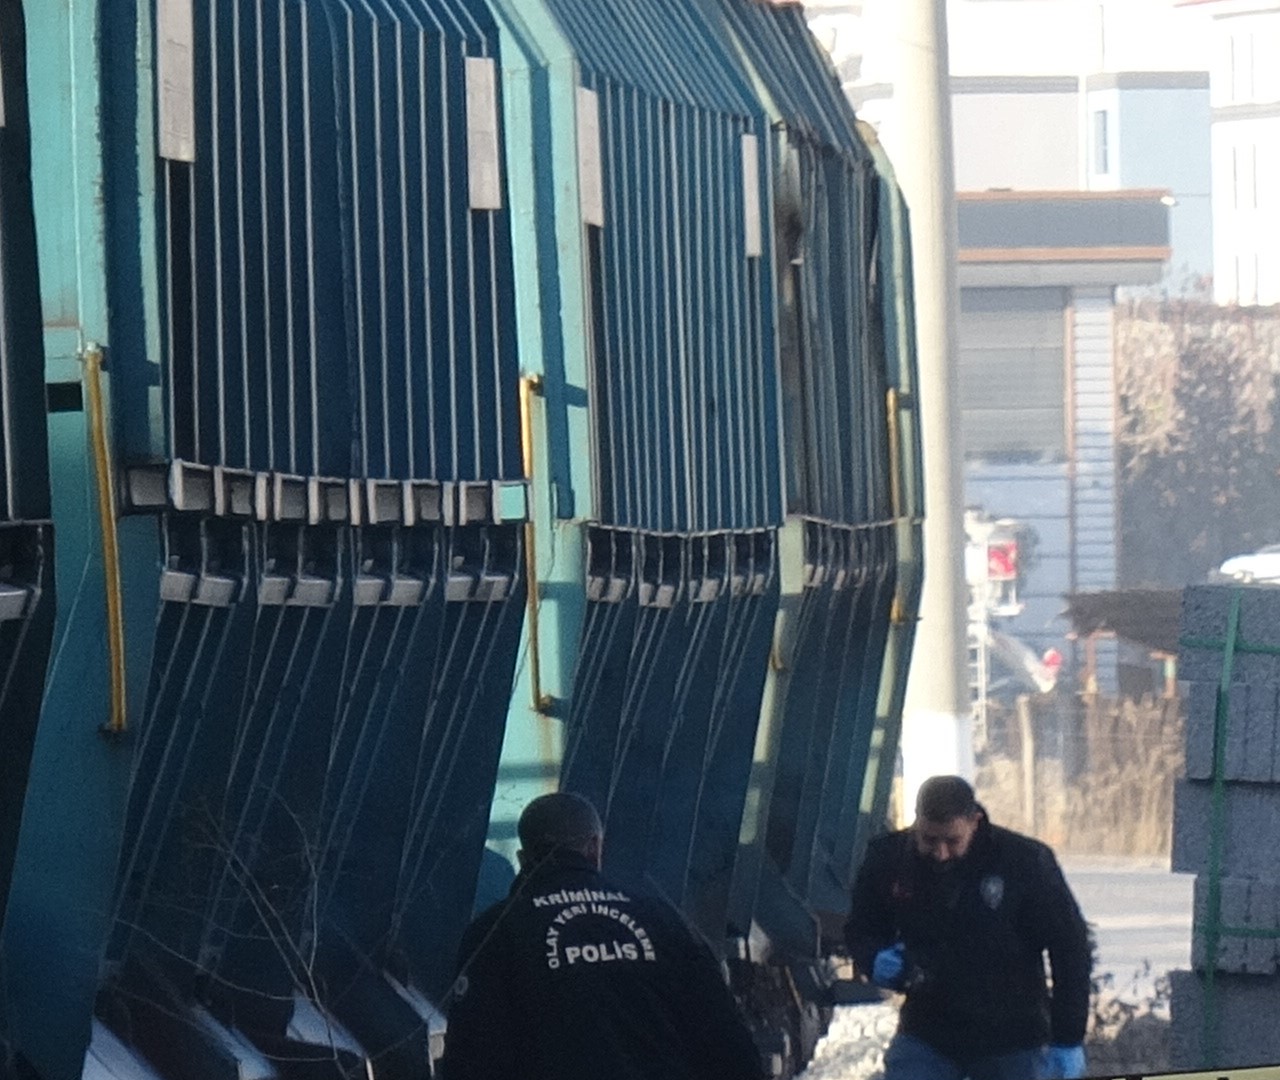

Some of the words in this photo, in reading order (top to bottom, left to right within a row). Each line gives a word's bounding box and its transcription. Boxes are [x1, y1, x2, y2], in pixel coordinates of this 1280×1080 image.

[533, 888, 630, 907] KRİMİNAL
[546, 926, 560, 969] OLAY
[553, 902, 587, 925] YERİ
[591, 902, 656, 961] İNCELEME
[565, 941, 639, 964] POLİS
